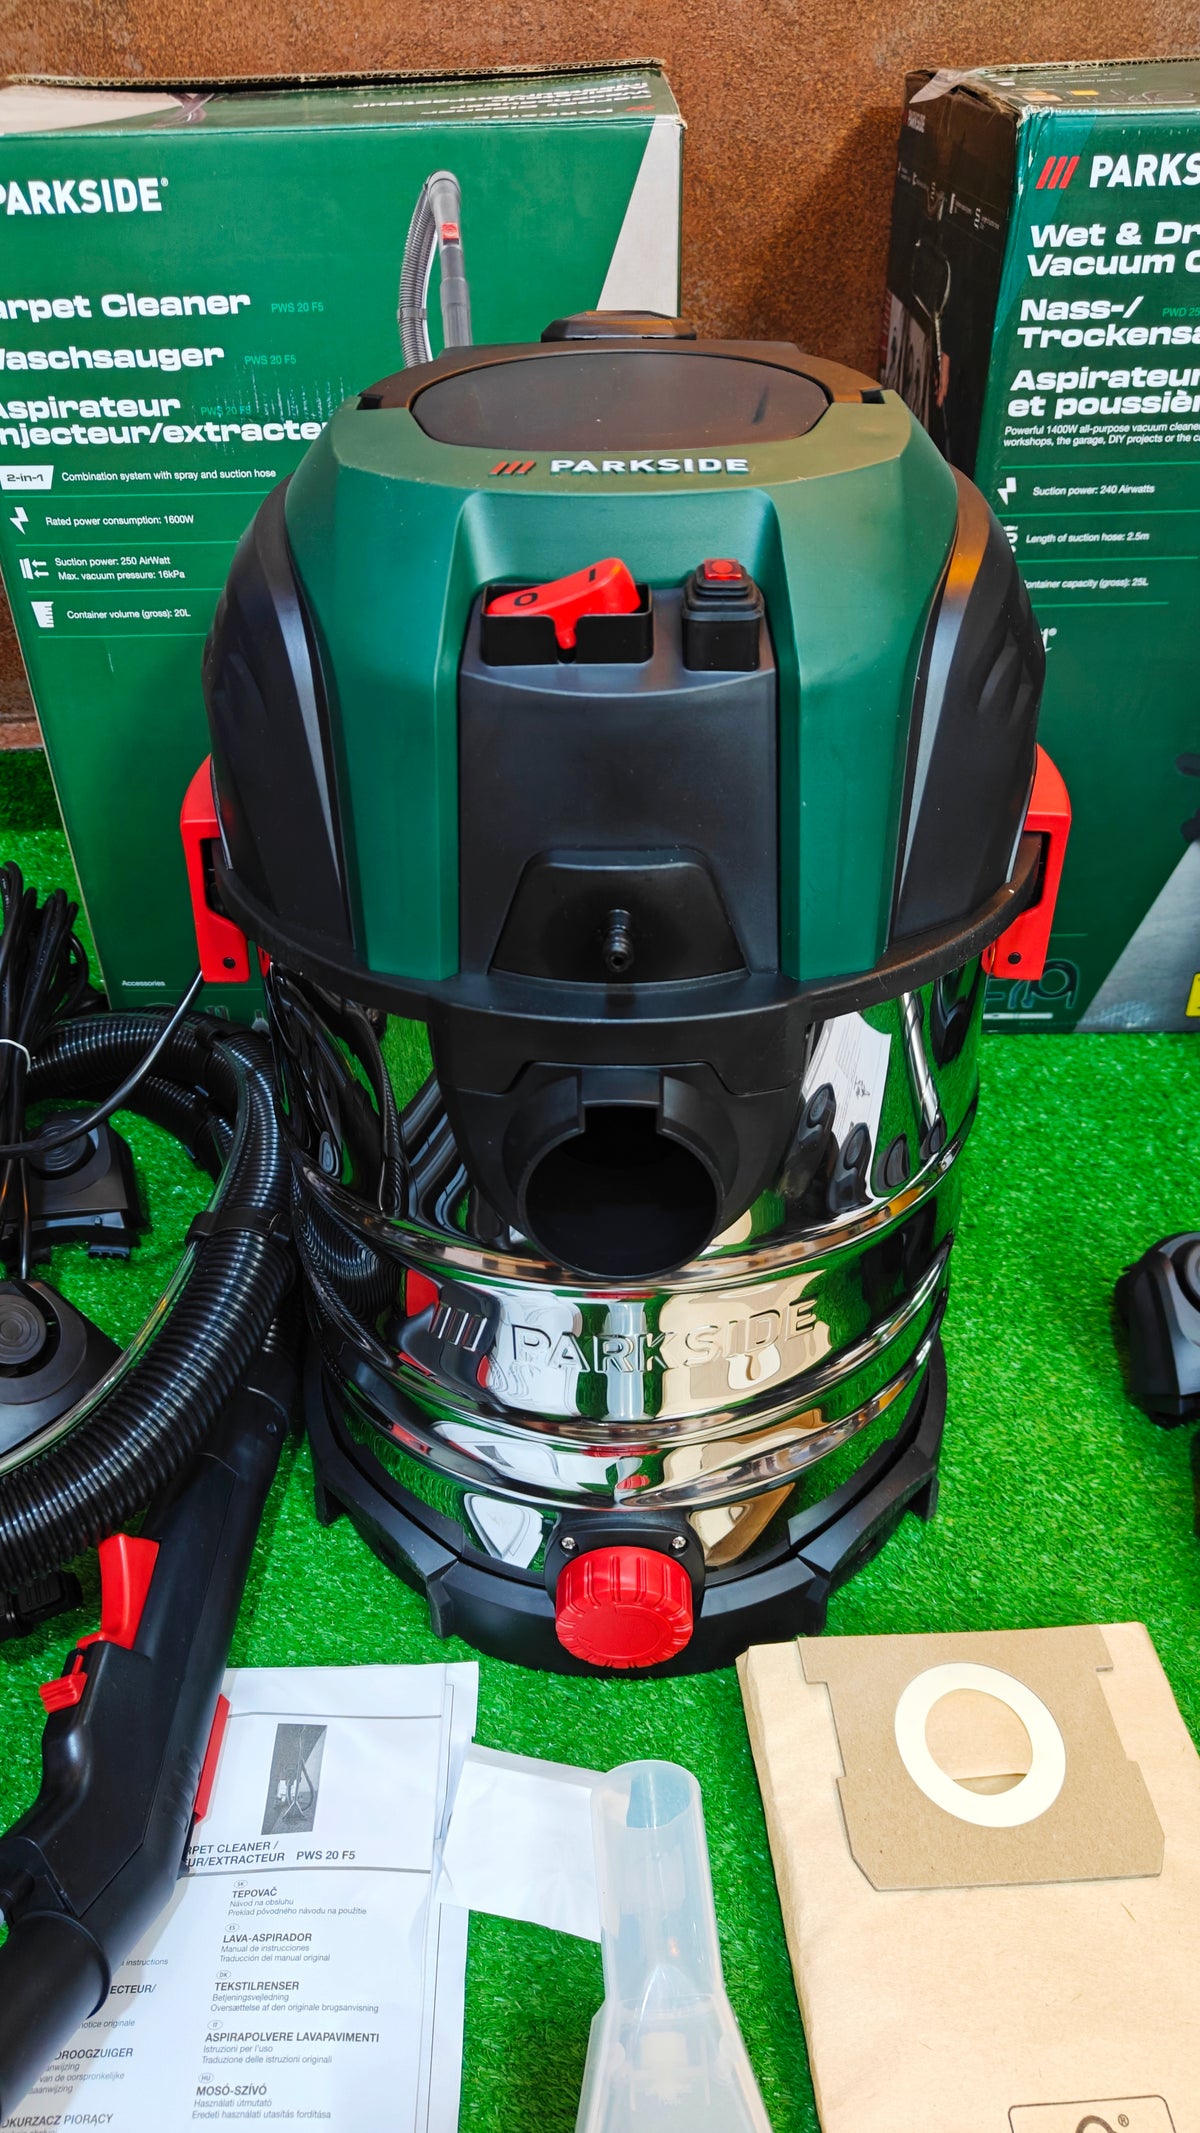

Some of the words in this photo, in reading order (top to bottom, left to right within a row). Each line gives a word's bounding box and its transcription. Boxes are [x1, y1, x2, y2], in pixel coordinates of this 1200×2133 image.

[1030, 224, 1106, 248] Wet
[1115, 222, 1142, 245] &
[1027, 253, 1175, 277] Vacuum
[101, 293, 251, 318] Cleaner
[271, 303, 295, 313] PWS
[297, 302, 309, 313] 20
[312, 302, 324, 312] F5
[1020, 295, 1144, 321] Nass-/
[1162, 307, 1187, 317] PWD
[0, 346, 225, 371] aschsauger
[244, 355, 268, 365] PWS
[270, 355, 281, 365] 20
[285, 354, 297, 364] F5
[225, 406, 237, 415] 20
[1008, 396, 1047, 417] et
[1005, 425, 1045, 435] Powerful
[1046, 424, 1077, 434] 1400W
[1079, 423, 1130, 434] all-purpose
[1132, 423, 1167, 432] vacuum
[1003, 436, 1054, 447] workshops,
[1056, 436, 1071, 445] the
[1073, 437, 1106, 447] garage,
[1108, 434, 1125, 444] DIY
[1126, 434, 1163, 445] projects
[1165, 434, 1175, 442] or
[1176, 433, 1191, 442] the
[550, 458, 749, 474] PARKSIDE
[7, 474, 44, 482] 2-in-1
[62, 471, 118, 482] Combination
[120, 471, 152, 482] system
[153, 470, 172, 480] with
[174, 471, 198, 482] spray
[200, 469, 217, 479] and
[219, 469, 253, 479] suction
[254, 468, 277, 478] hose
[1032, 486, 1066, 496] Suction
[1067, 486, 1099, 497] power:
[1100, 485, 1117, 494] 240
[1118, 484, 1155, 494] Airwatts
[46, 516, 72, 526] Rated
[74, 517, 100, 527] power
[102, 516, 162, 527] consumption:
[164, 515, 194, 524] 1600W
[1025, 534, 1056, 544] Length
[1057, 533, 1067, 542] of
[1068, 533, 1100, 542] suction
[1101, 532, 1126, 541] hose:
[55, 557, 88, 567] Suction
[90, 557, 119, 568] power:
[120, 557, 137, 566] 250
[139, 556, 171, 565] AirWatt
[58, 571, 79, 580] Max.
[81, 571, 115, 580] vacuum
[117, 571, 156, 581] pressure:
[158, 569, 186, 578] 16kPa
[1062, 579, 1098, 590] capacity
[66, 610, 107, 619] Container
[108, 609, 140, 619] volume
[142, 609, 172, 620] (gross):
[174, 608, 191, 617] 20L
[121, 979, 166, 987] Accessories
[511, 1297, 818, 1375] PARKSIDE
[216, 1841, 271, 1853] CLEANER
[296, 1850, 323, 1860] PWS
[325, 1850, 339, 1860] 20
[341, 1850, 356, 1860] F5
[232, 1887, 278, 1898] TEPOVAČ
[230, 1899, 254, 1908] Návod
[265, 1898, 294, 1907] obsluhu
[228, 1908, 255, 1916] Preklad
[223, 1933, 313, 1943] LAVA-ASPIRADOR
[221, 1945, 248, 1953] Manual
[249, 1944, 260, 1952] de
[261, 1944, 310, 1952] instrucciones
[125, 1958, 169, 1966] instructions
[219, 1954, 260, 1963] Traducción
[261, 1953, 273, 1962] del
[274, 1953, 302, 1962] manual
[303, 1953, 331, 1963] original
[214, 1981, 300, 1991] TEKSTILRENSER
[210, 2003, 260, 2012] Oversættelse
[261, 2003, 271, 2012] af
[271, 2003, 286, 2012] den
[287, 2003, 320, 2013] originale
[321, 2003, 379, 2014] brugsanvisning
[103, 2019, 135, 2029] originale
[205, 2032, 294, 2043] ASPIRAPOLVERE
[296, 2031, 380, 2043] LAVAPAVIMENTI
[203, 2044, 238, 2053] Istruzioni
[239, 2045, 253, 2055] per
[202, 2055, 243, 2064] Traduzione
[244, 2055, 264, 2064] delle
[265, 2055, 300, 2064] istruzioni
[301, 2055, 333, 2065] originali
[54, 2073, 65, 2082] de
[196, 2083, 267, 2096] MOSÓ-SZÍVÓ
[193, 2098, 235, 2108] Használati
[63, 2112, 114, 2127] PIORĄCY
[191, 2110, 220, 2119] Eredeti
